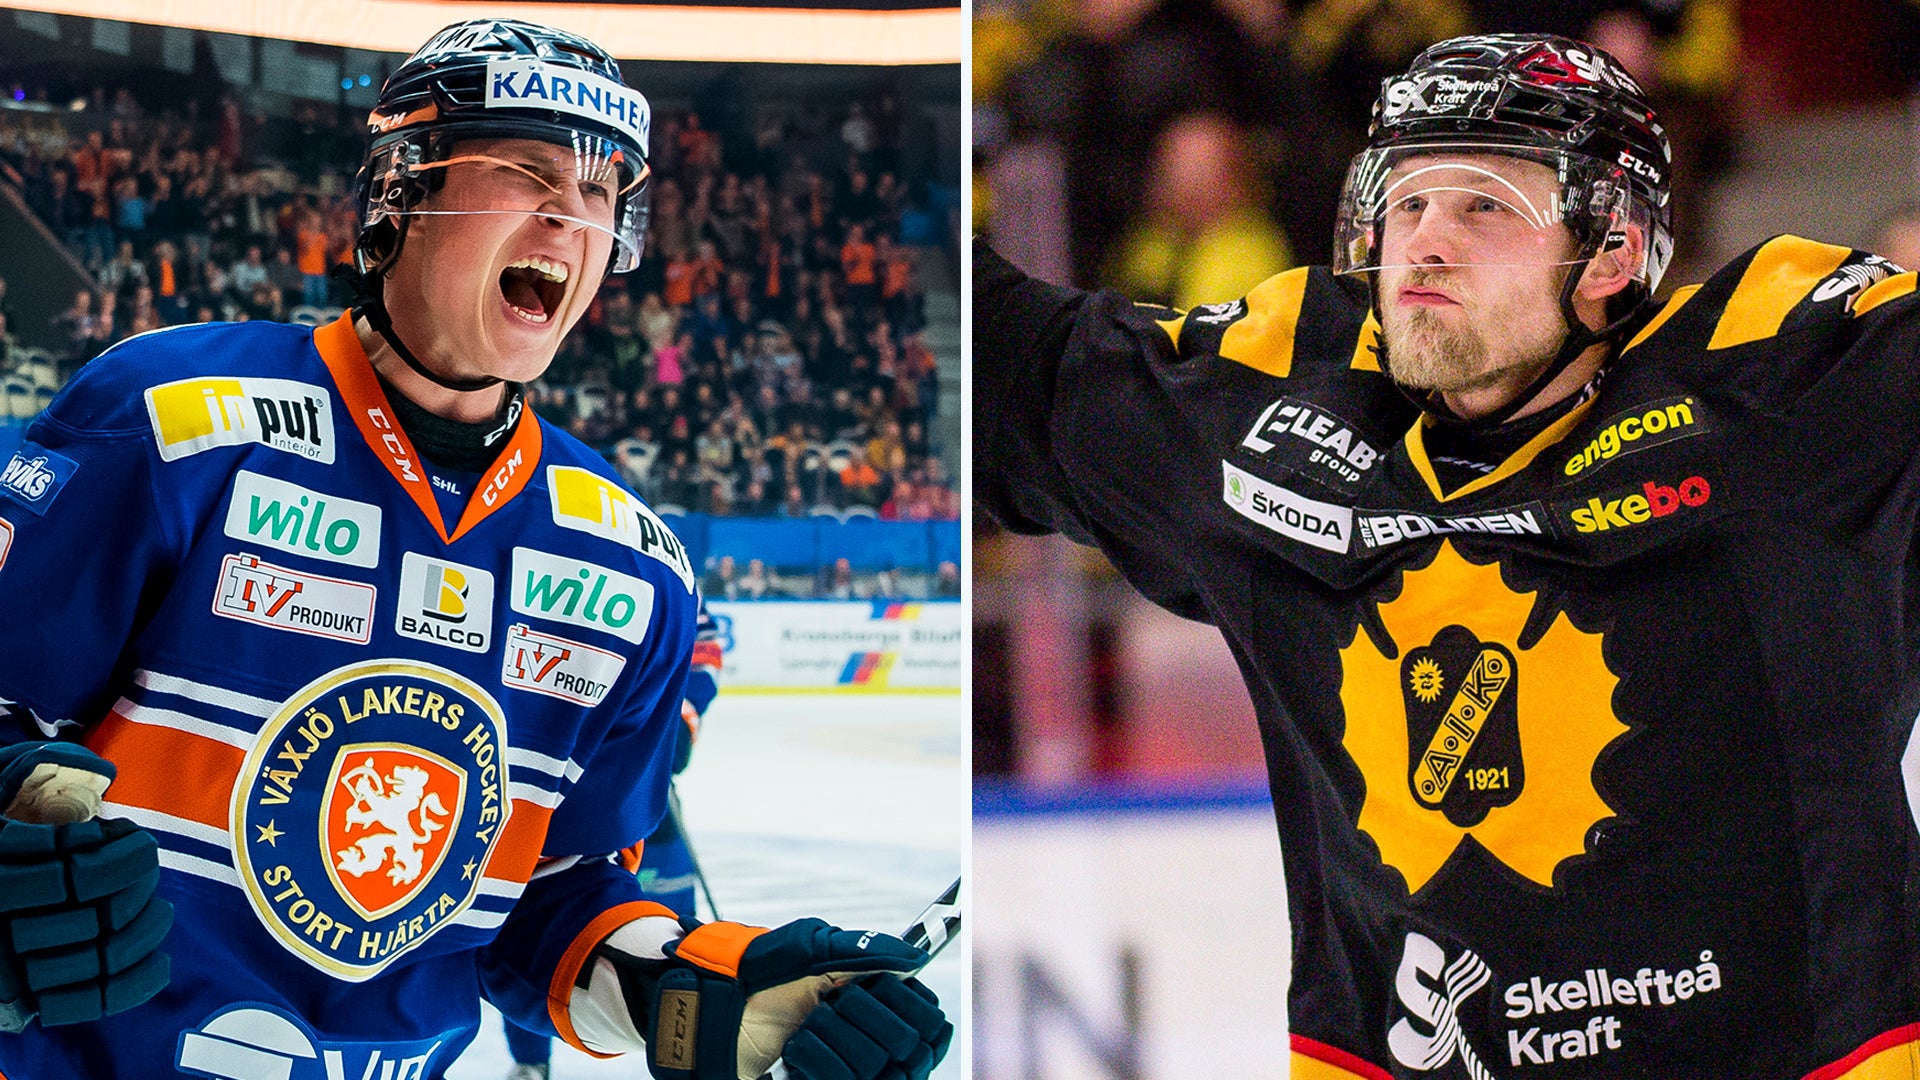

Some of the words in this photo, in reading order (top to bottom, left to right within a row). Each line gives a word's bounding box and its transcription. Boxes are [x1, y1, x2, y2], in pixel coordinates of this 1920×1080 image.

[371, 111, 407, 134] CCM
[1433, 93, 1466, 104] Kraft
[274, 436, 321, 459] interiör
[367, 406, 420, 483] CCM
[1563, 401, 1694, 477] engcon
[432, 475, 461, 495] SHL
[481, 448, 523, 507] CCM
[1309, 449, 1360, 482] group
[248, 495, 360, 556] wilo
[1252, 491, 1342, 541] ŠKODA
[1368, 510, 1543, 547] BOLIDEN
[1570, 475, 1711, 533] skebo
[289, 605, 365, 634] PRODUKT
[524, 568, 636, 629] wilo
[401, 617, 484, 648] BALCO
[553, 671, 608, 700] PRODKT
[259, 706, 335, 806] VÄXJÖ
[338, 684, 466, 732] LAKERS
[461, 721, 499, 846] HOCKEY
[1464, 766, 1510, 791] 1921
[262, 863, 354, 952] STORT
[357, 892, 457, 960] HJÄRTA
[1504, 949, 1723, 1019] Skellefteå
[1507, 1015, 1623, 1068] Kraft
